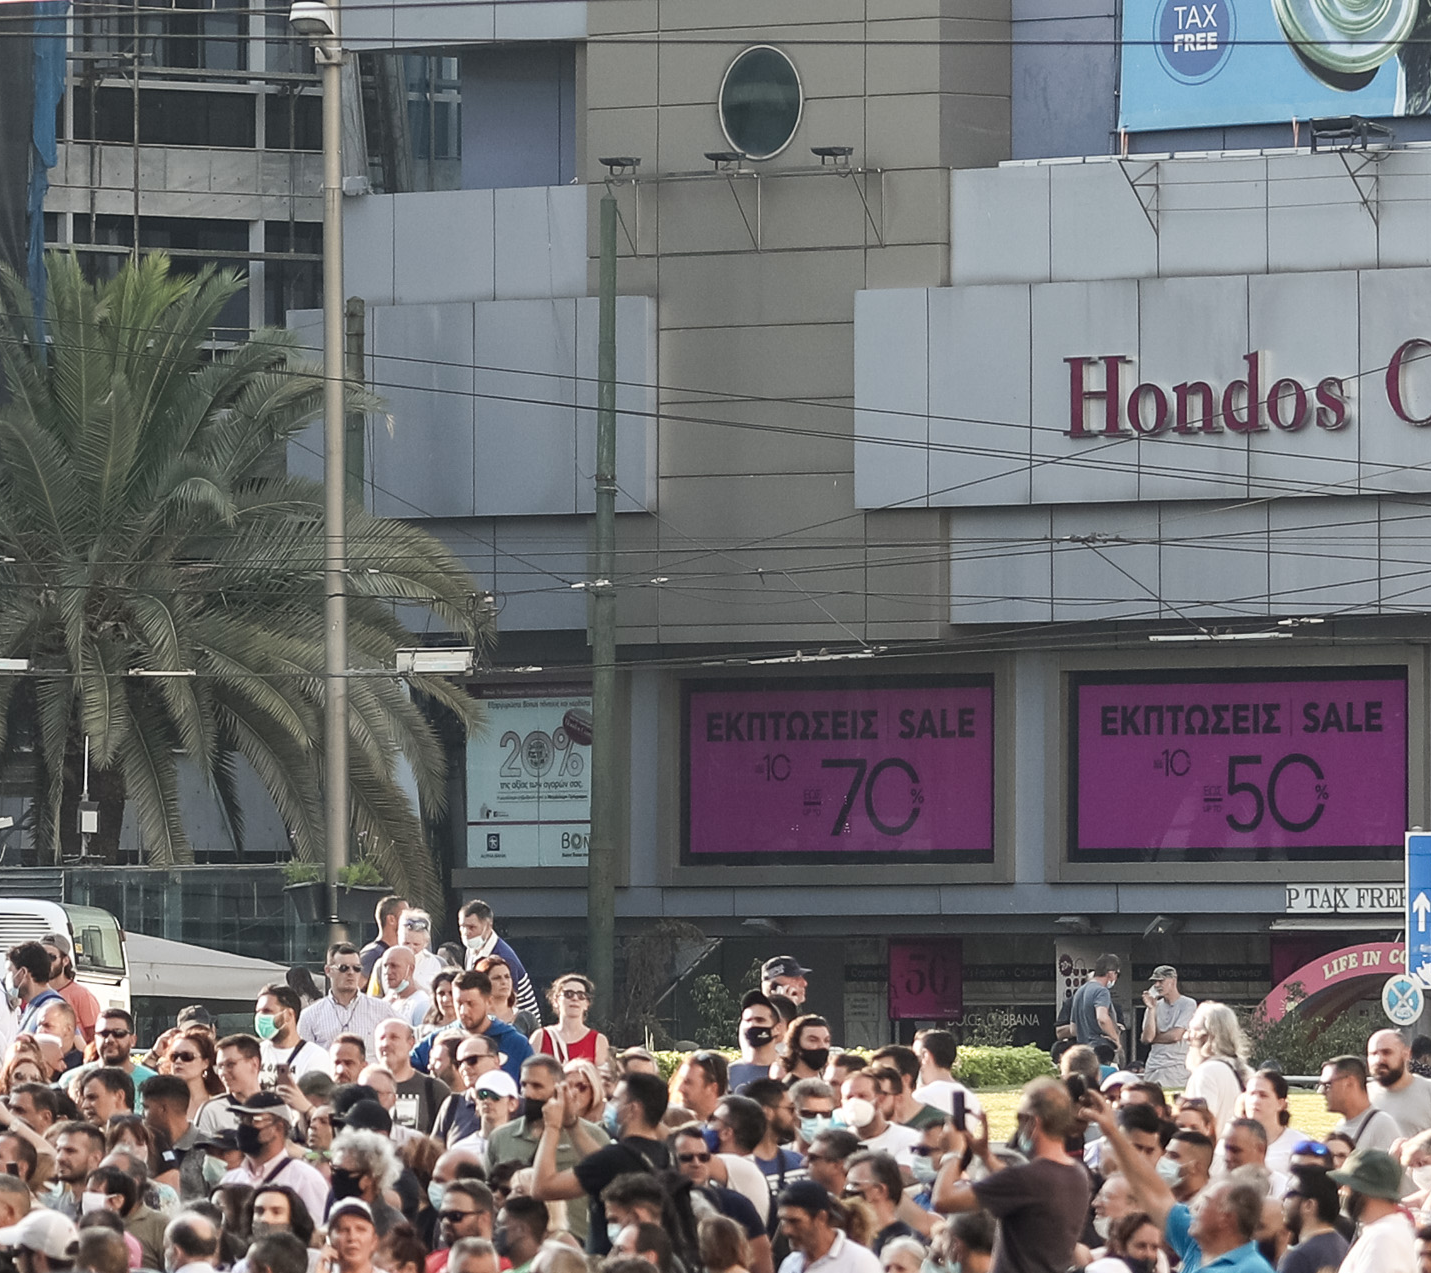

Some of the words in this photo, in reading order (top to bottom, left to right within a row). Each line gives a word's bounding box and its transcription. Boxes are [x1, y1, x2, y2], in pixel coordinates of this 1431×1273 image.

[1173, 2, 1219, 31] TAX
[1172, 31, 1219, 54] FREE
[1062, 349, 1350, 439] Hondos
[706, 710, 879, 742] ΕΚΠΤΩΣΕΙΣ
[898, 709, 977, 740] SALE
[1100, 702, 1282, 736] ΕΚΠΤΩΣΕΙΣ
[1302, 701, 1383, 734] SALE
[499, 726, 584, 778] 20%
[1304, 887, 1350, 909] TAX
[1321, 949, 1359, 981] LIFE
[1361, 950, 1382, 968] IN
